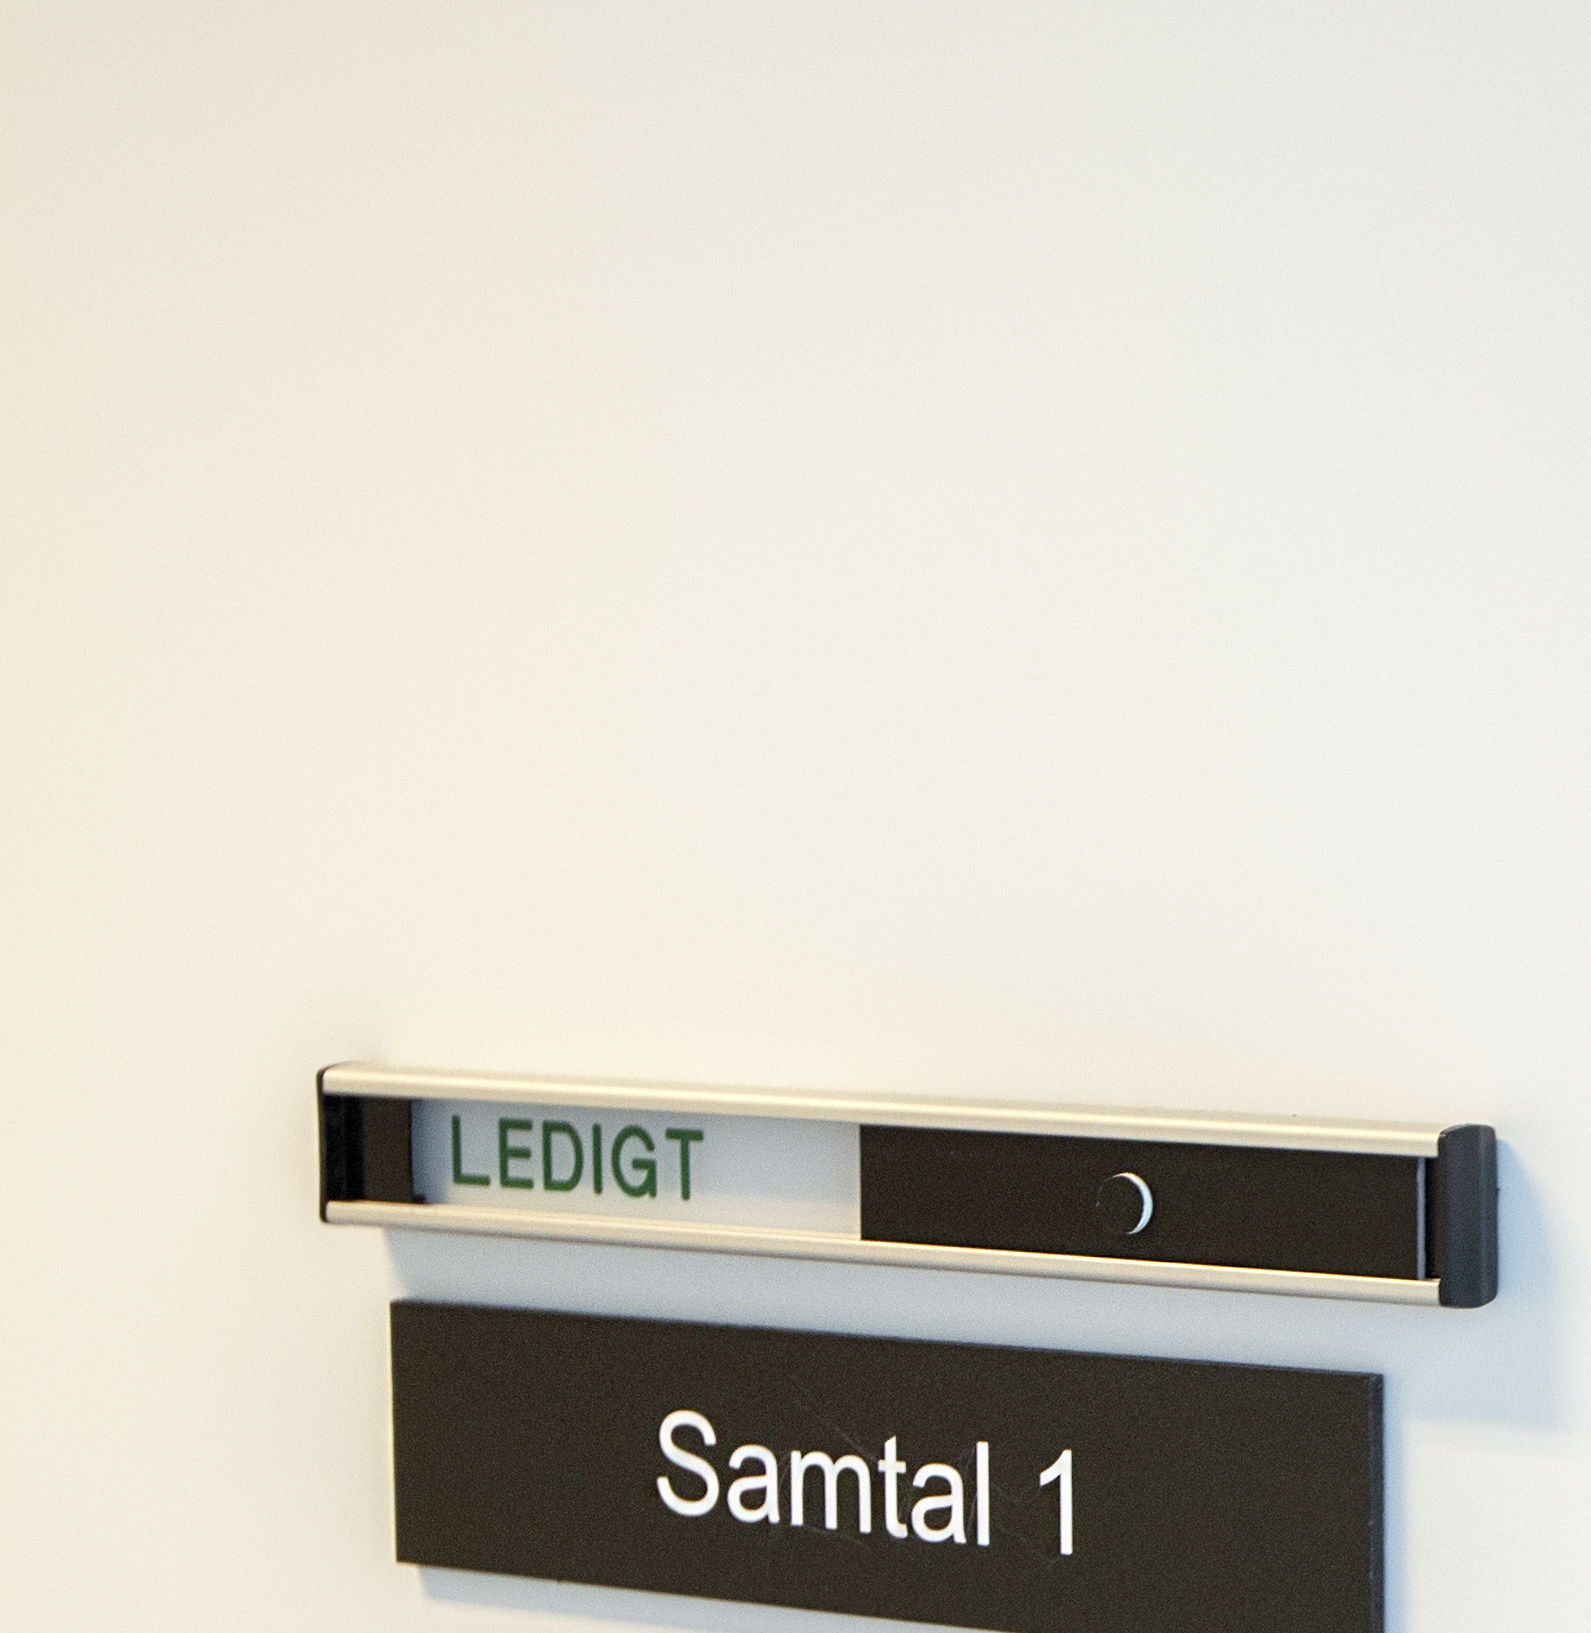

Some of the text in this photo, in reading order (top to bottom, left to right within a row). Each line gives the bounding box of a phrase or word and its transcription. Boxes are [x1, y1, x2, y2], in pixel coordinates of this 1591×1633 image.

[450, 1113, 705, 1200] LEDIGT
[656, 1409, 1075, 1556] Samtal 1
